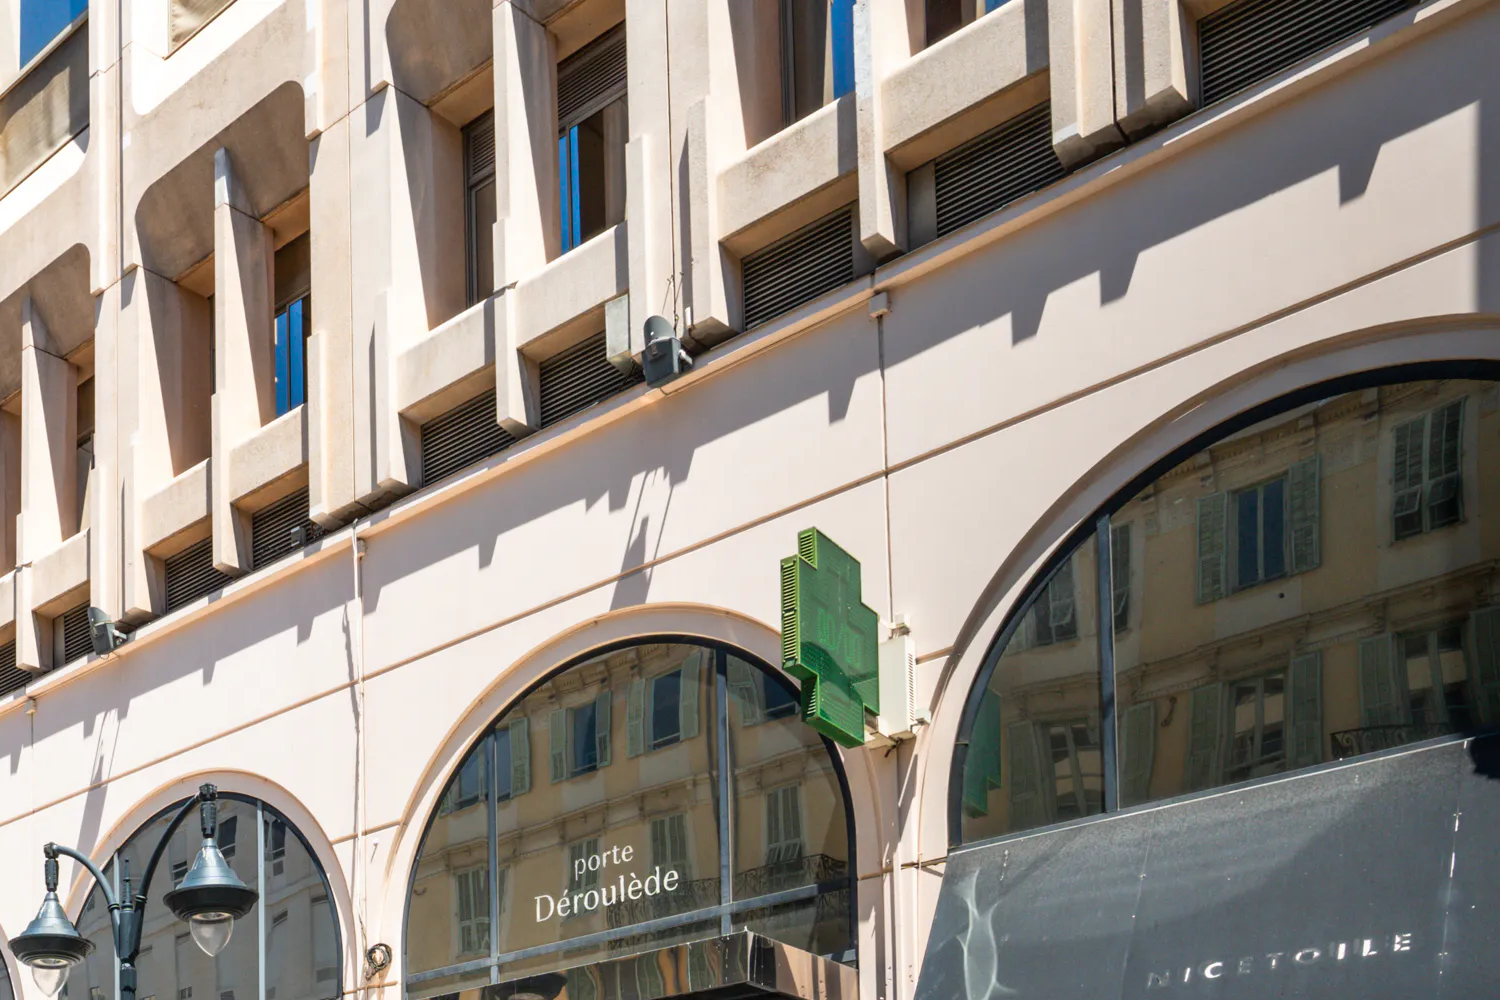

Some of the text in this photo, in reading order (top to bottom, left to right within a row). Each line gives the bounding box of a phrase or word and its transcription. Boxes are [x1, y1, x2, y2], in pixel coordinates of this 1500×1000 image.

[575, 845, 634, 880] porte
[534, 866, 679, 923] Déroulède
[1148, 932, 1412, 988] NICETOILE
